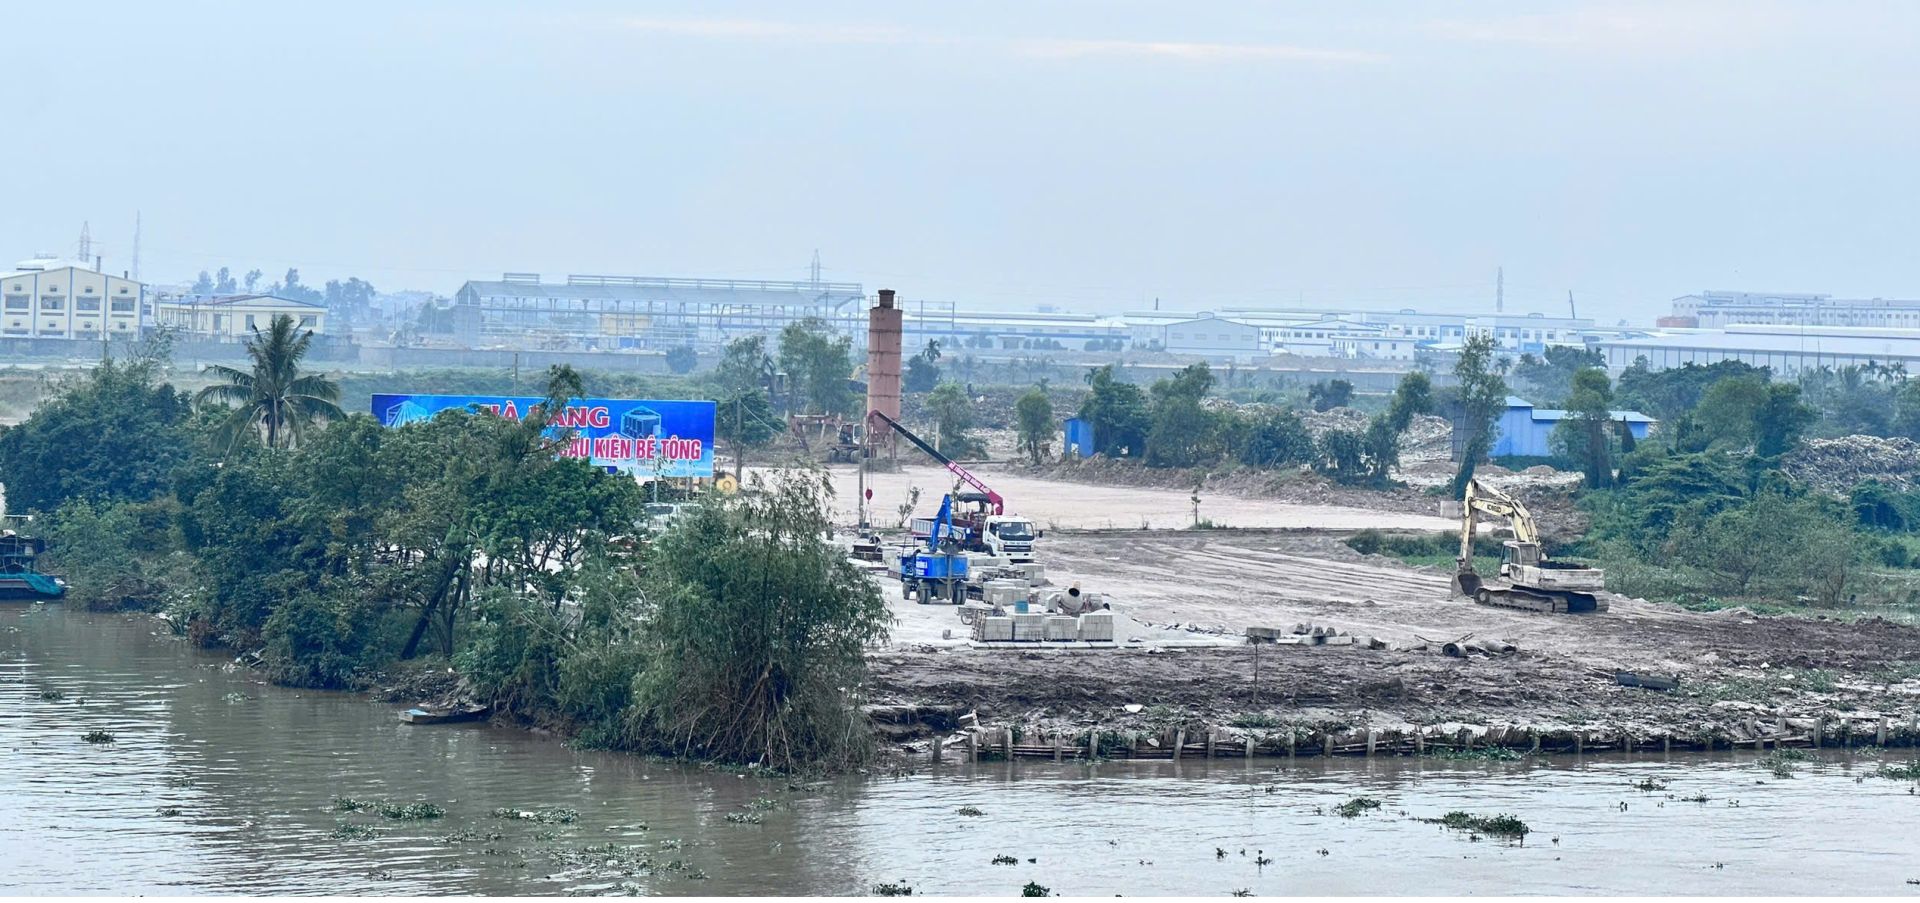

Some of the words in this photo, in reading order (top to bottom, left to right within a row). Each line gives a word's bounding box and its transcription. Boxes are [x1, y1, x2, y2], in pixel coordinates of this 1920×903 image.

[594, 434, 631, 463] KIỆN
[636, 435, 657, 460] BÊ
[661, 434, 702, 461] TÔNG
